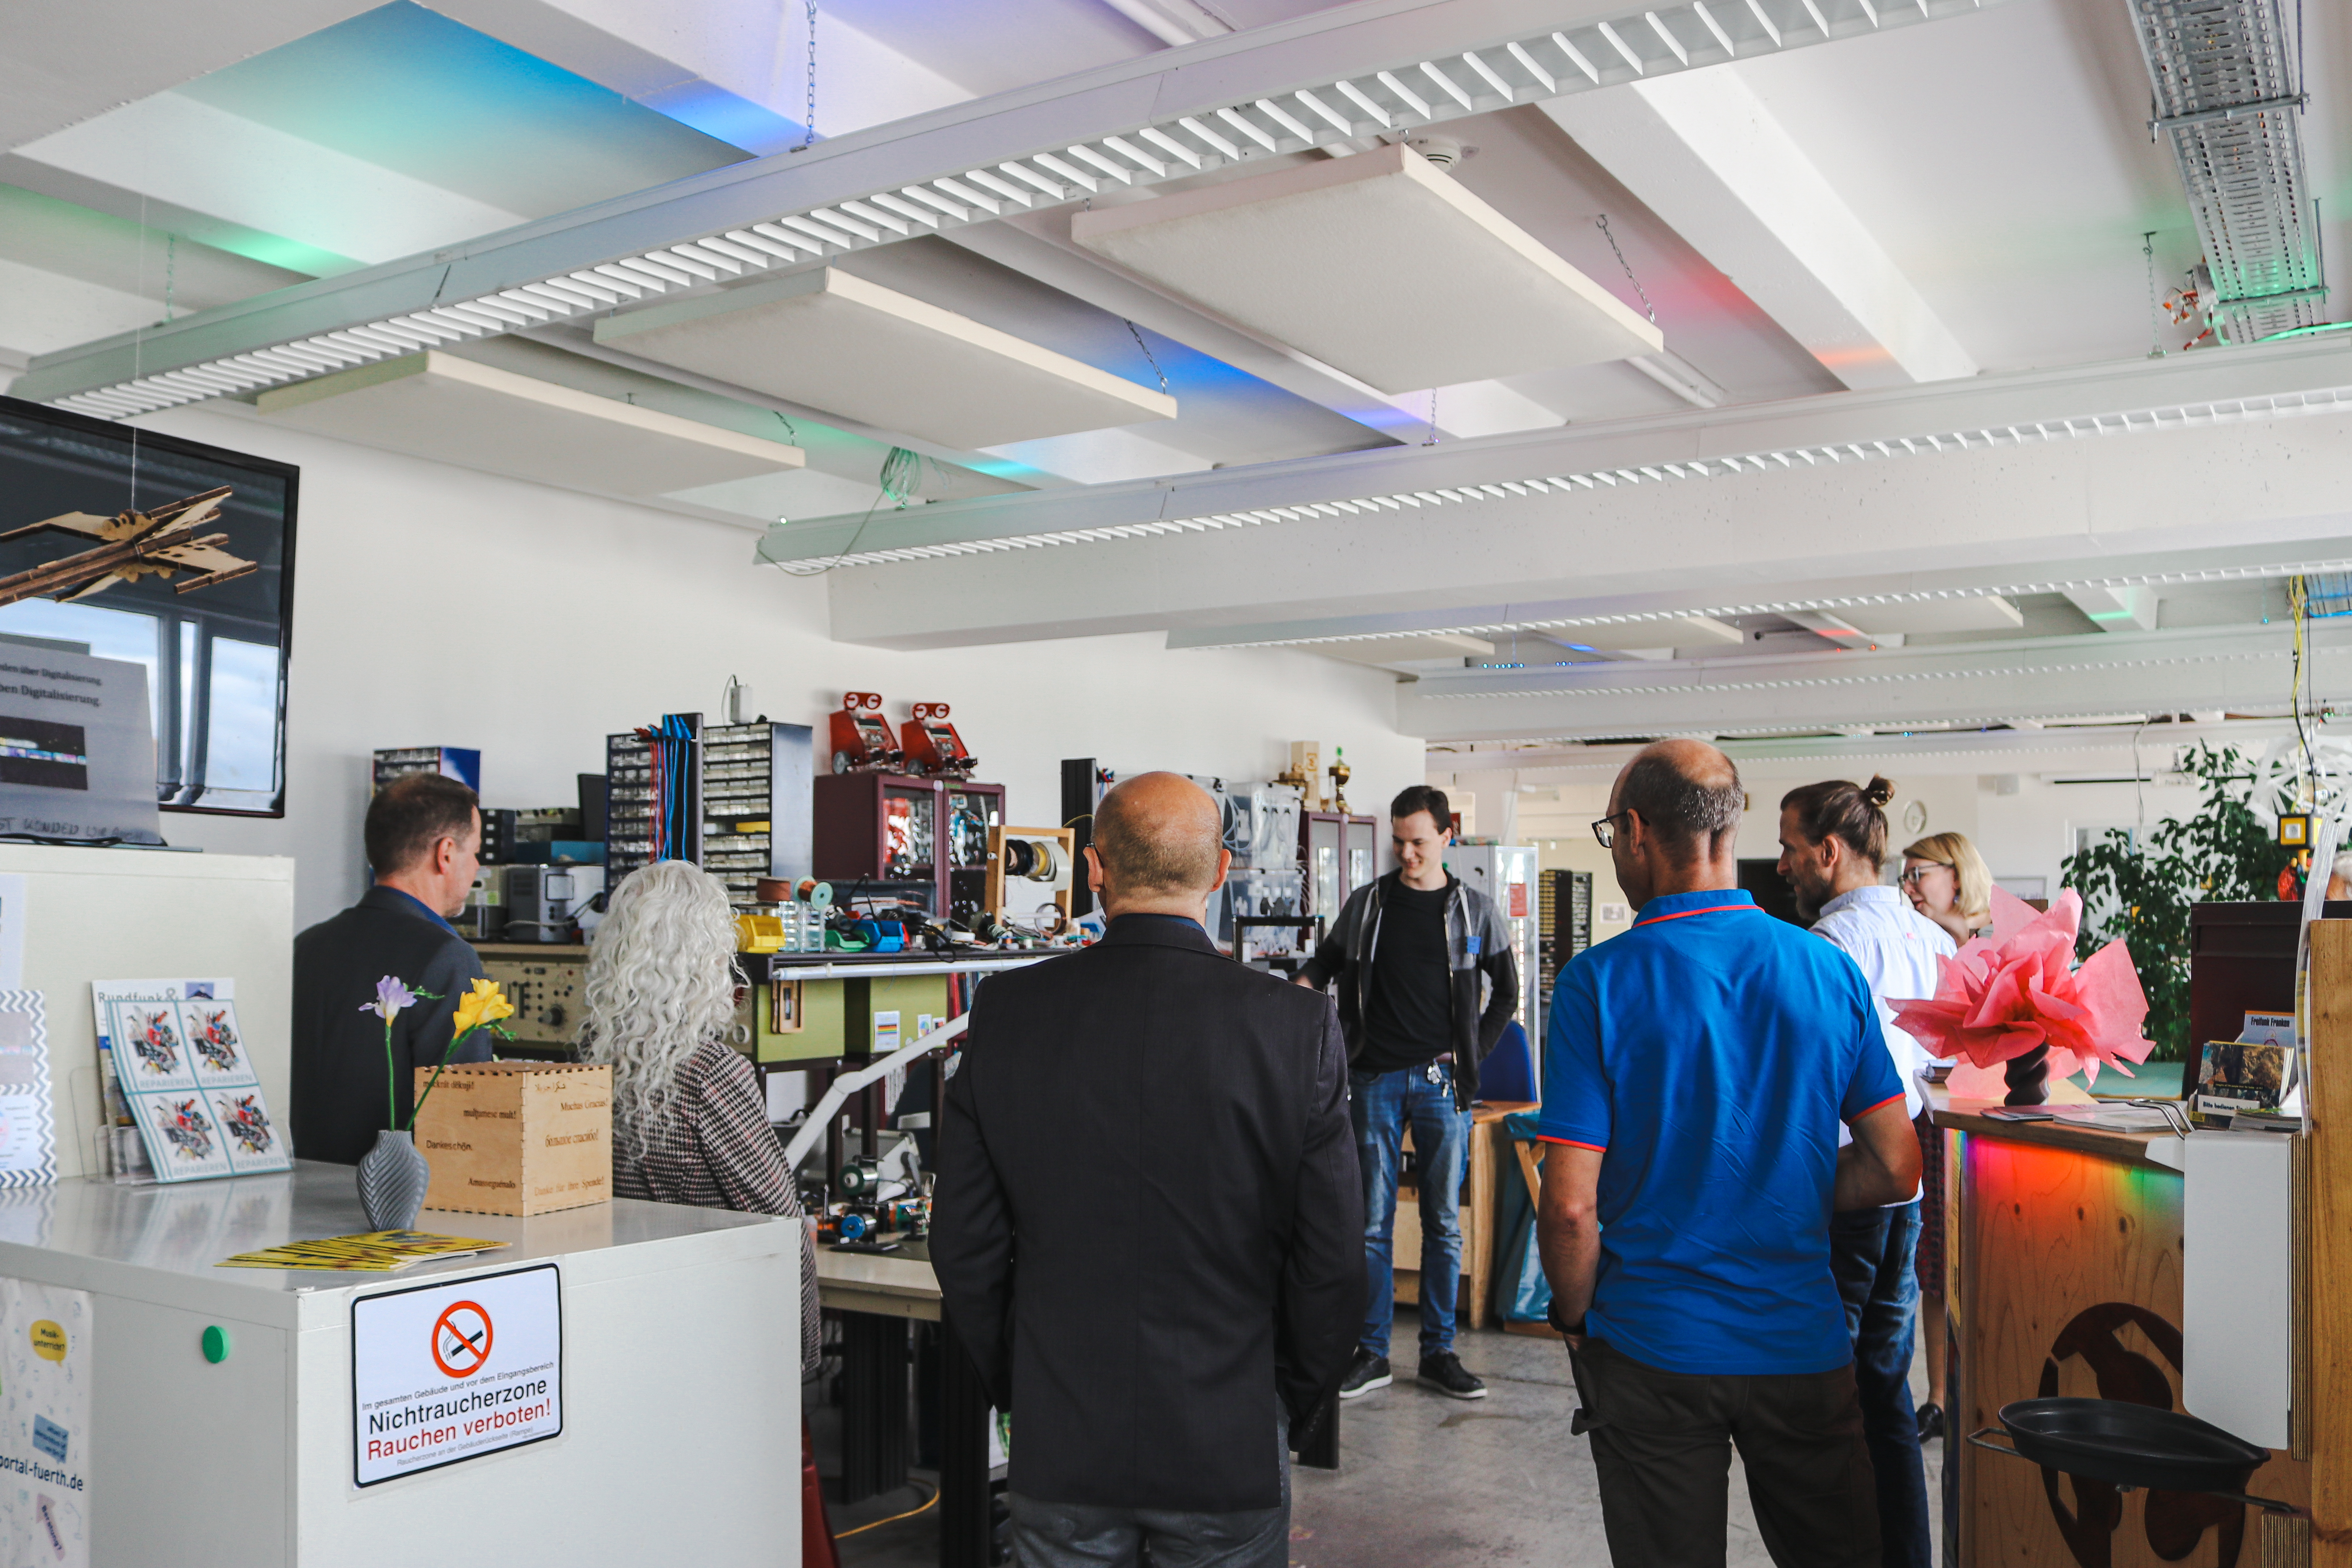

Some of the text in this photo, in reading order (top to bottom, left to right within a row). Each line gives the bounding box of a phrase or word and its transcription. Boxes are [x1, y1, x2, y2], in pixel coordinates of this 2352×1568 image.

[41, 668, 102, 686] Digitalisierung
[21, 685, 99, 707] Digitalisierung
[99, 991, 163, 1002] Rundfunk
[2251, 1016, 2290, 1028] Freifunk Franken
[140, 1078, 193, 1088] REPARIEREN
[201, 1074, 252, 1084] REPARIEREN
[561, 1097, 608, 1111] Muchas Gracias!
[581, 1176, 605, 1190] Spende!
[41, 1328, 59, 1338] Musik-
[33, 1340, 65, 1351] unterricht?
[362, 1402, 372, 1411] Im
[374, 1394, 412, 1410] gesamten
[414, 1386, 448, 1399] Gebäude
[450, 1382, 464, 1391] und
[480, 1376, 495, 1384] dem
[497, 1361, 554, 1380] Eingangsbereich
[369, 1380, 547, 1435] Nichtraucherzone
[367, 1398, 551, 1461] Rauchen verboten!
[397, 1451, 437, 1466] Raucherzone
[446, 1445, 457, 1454] der
[457, 1433, 509, 1451] Gebäuderückseite
[509, 1426, 533, 1439] (Rampe)
